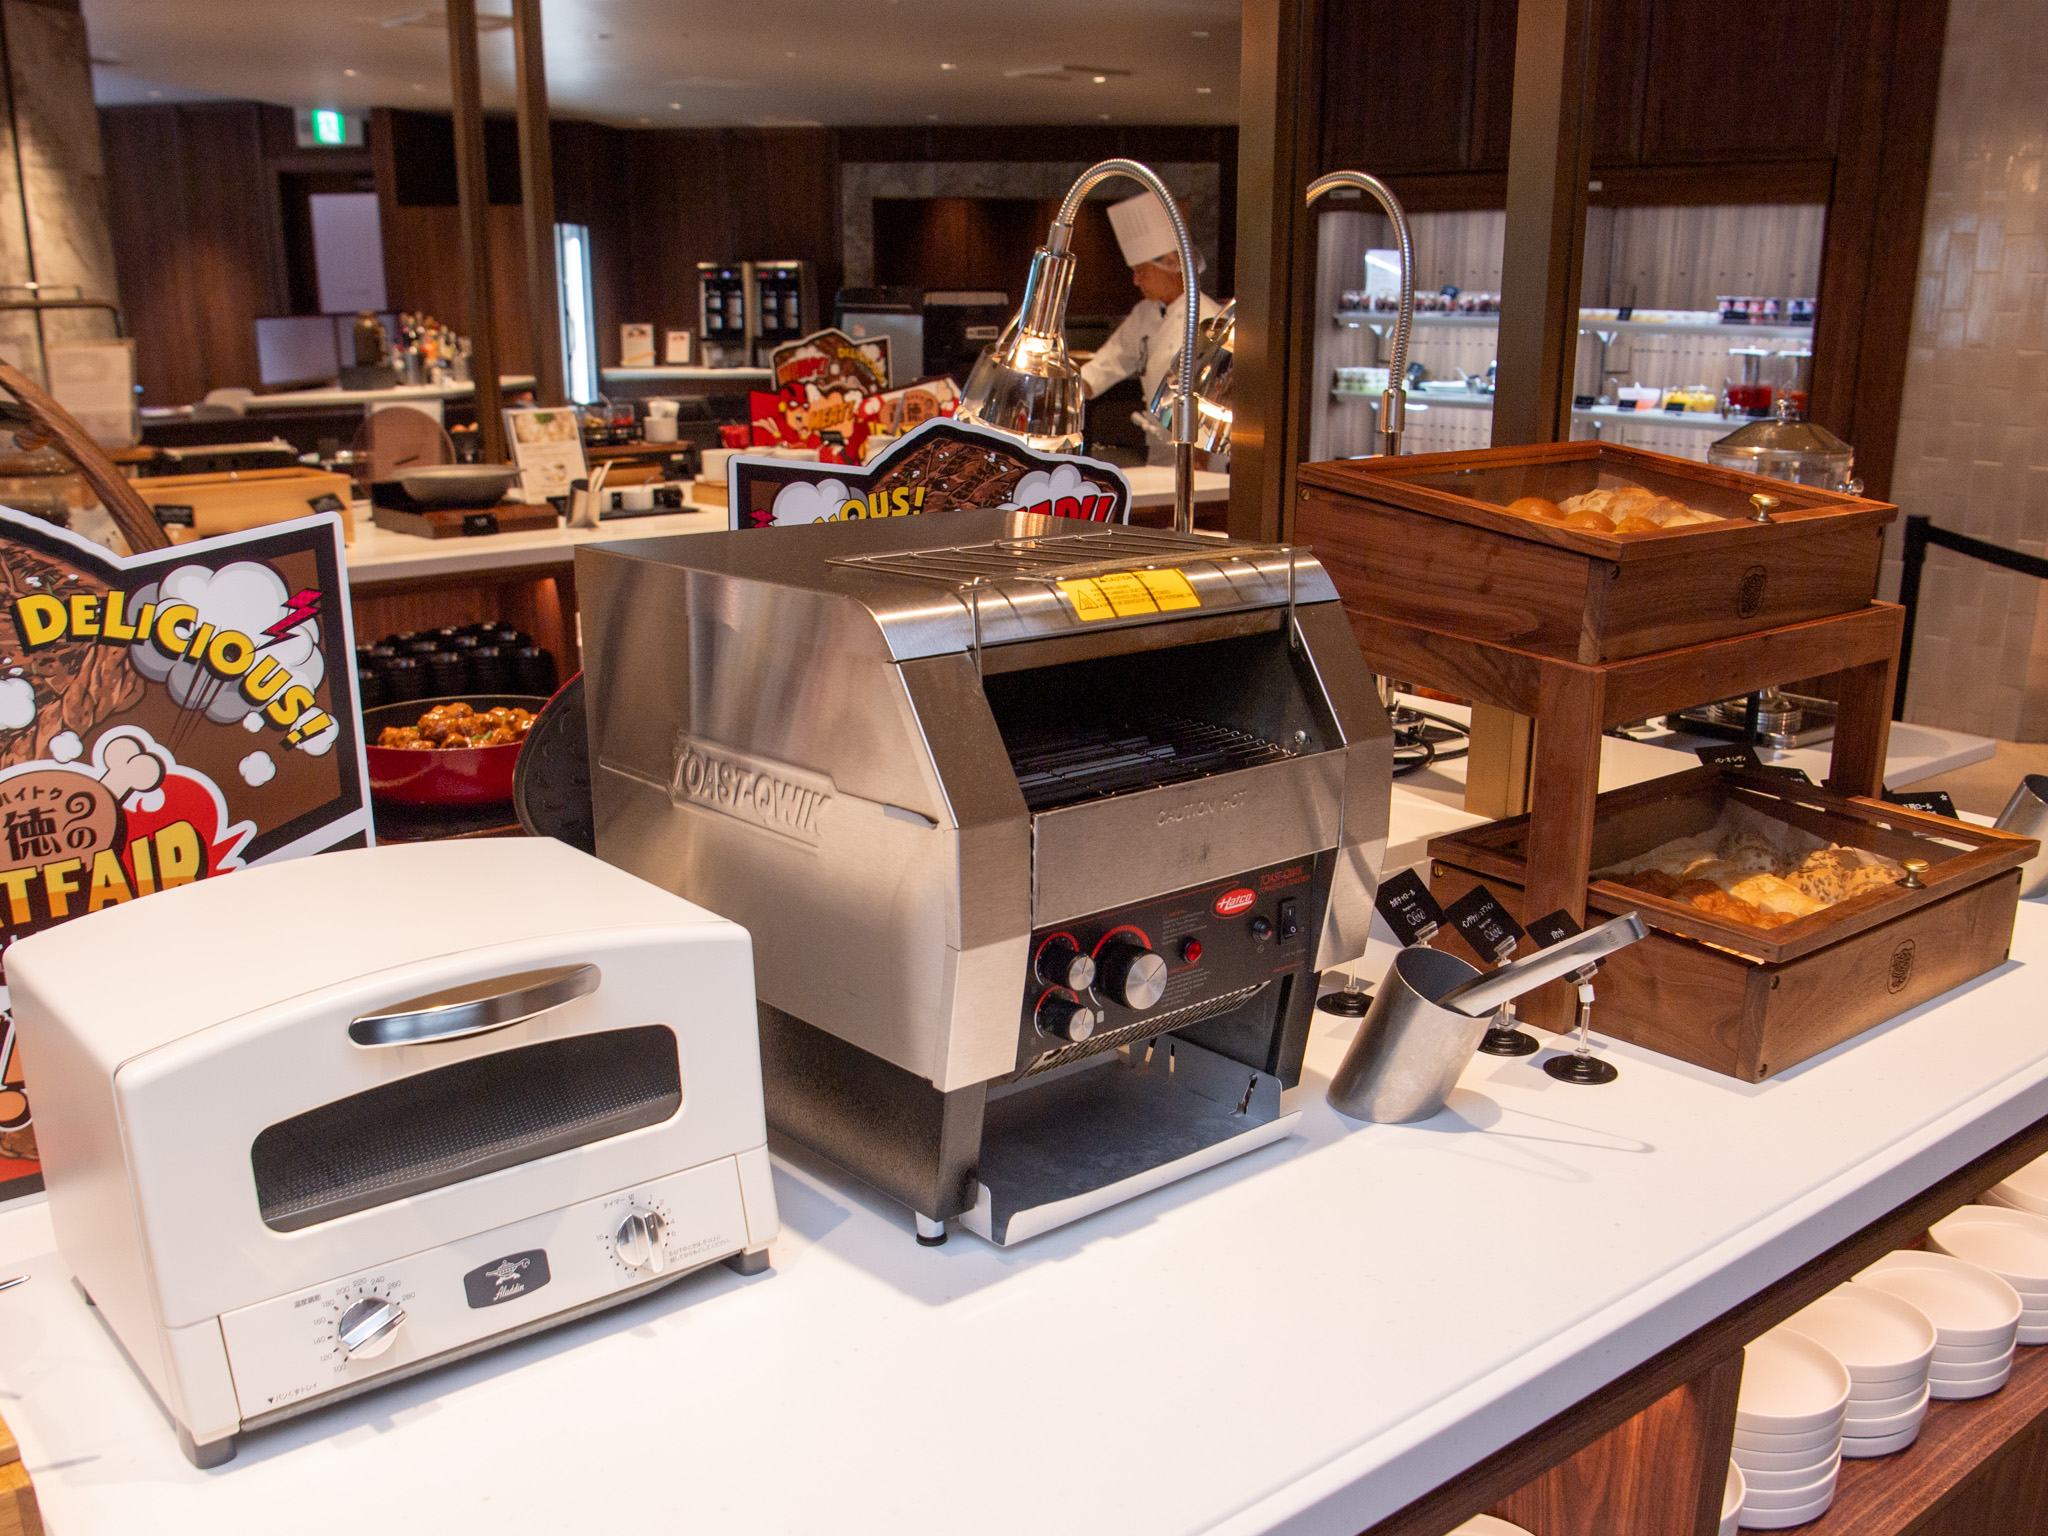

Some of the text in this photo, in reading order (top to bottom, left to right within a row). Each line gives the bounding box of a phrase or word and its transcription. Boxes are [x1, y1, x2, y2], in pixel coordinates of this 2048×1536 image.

[1217, 893, 1253, 911] Hatco
[353, 1278, 367, 1287] 220
[371, 1276, 385, 1286] 240
[388, 1280, 401, 1290] 260
[336, 1286, 350, 1296] 200
[493, 1282, 525, 1301] Aladdin
[402, 1292, 416, 1301] 280
[322, 1299, 336, 1308] 180
[313, 1316, 326, 1326] 160
[313, 1336, 326, 1345] 140
[320, 1352, 333, 1362] 120
[334, 1364, 347, 1373] 100
